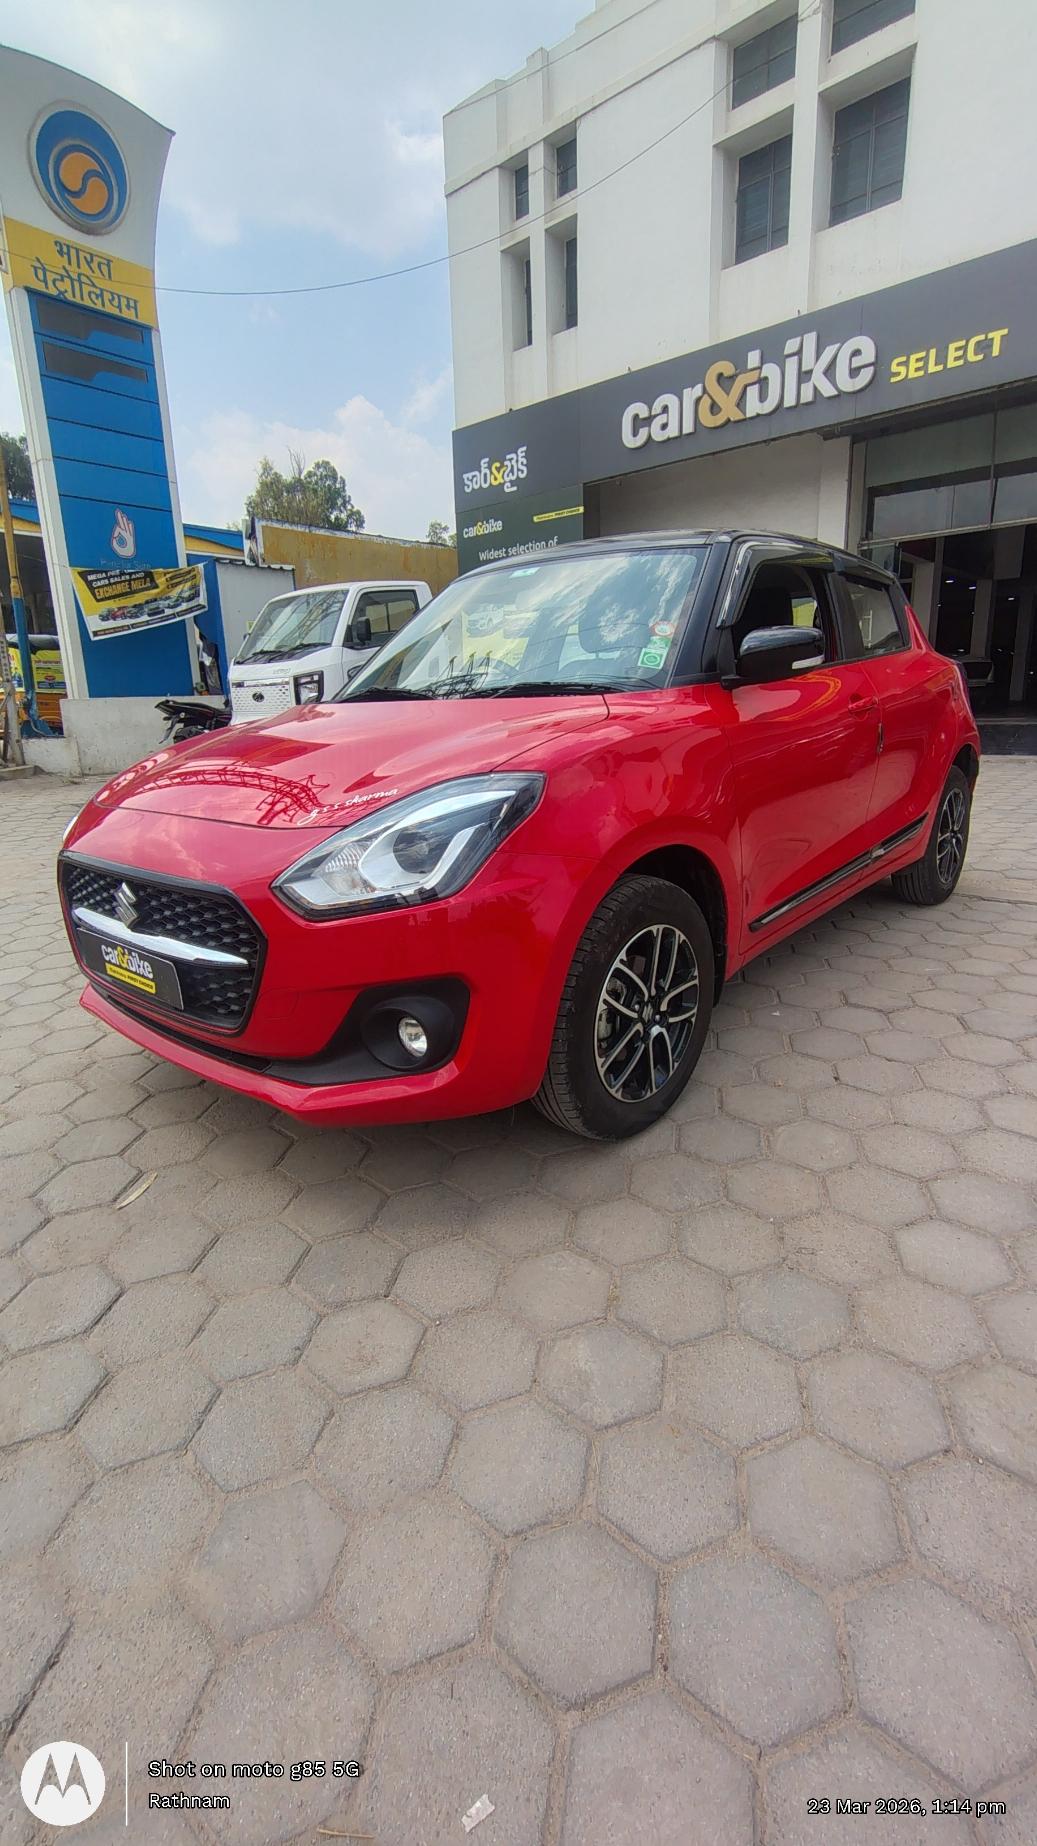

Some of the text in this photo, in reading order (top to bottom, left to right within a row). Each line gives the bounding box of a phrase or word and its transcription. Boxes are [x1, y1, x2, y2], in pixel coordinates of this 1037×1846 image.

[54, 240, 113, 281] भारत
[31, 256, 140, 319] पेट्रोलियम
[621, 328, 1009, 449] car&bike SELECT
[463, 518, 503, 538] car&bike
[479, 536, 559, 561] Widest selection of
[87, 572, 107, 581] MEGA
[92, 572, 145, 588] CARS SALES AND
[95, 582, 130, 599] EXCHANGE
[130, 577, 151, 591] MELA
[101, 944, 154, 979] car&bike
